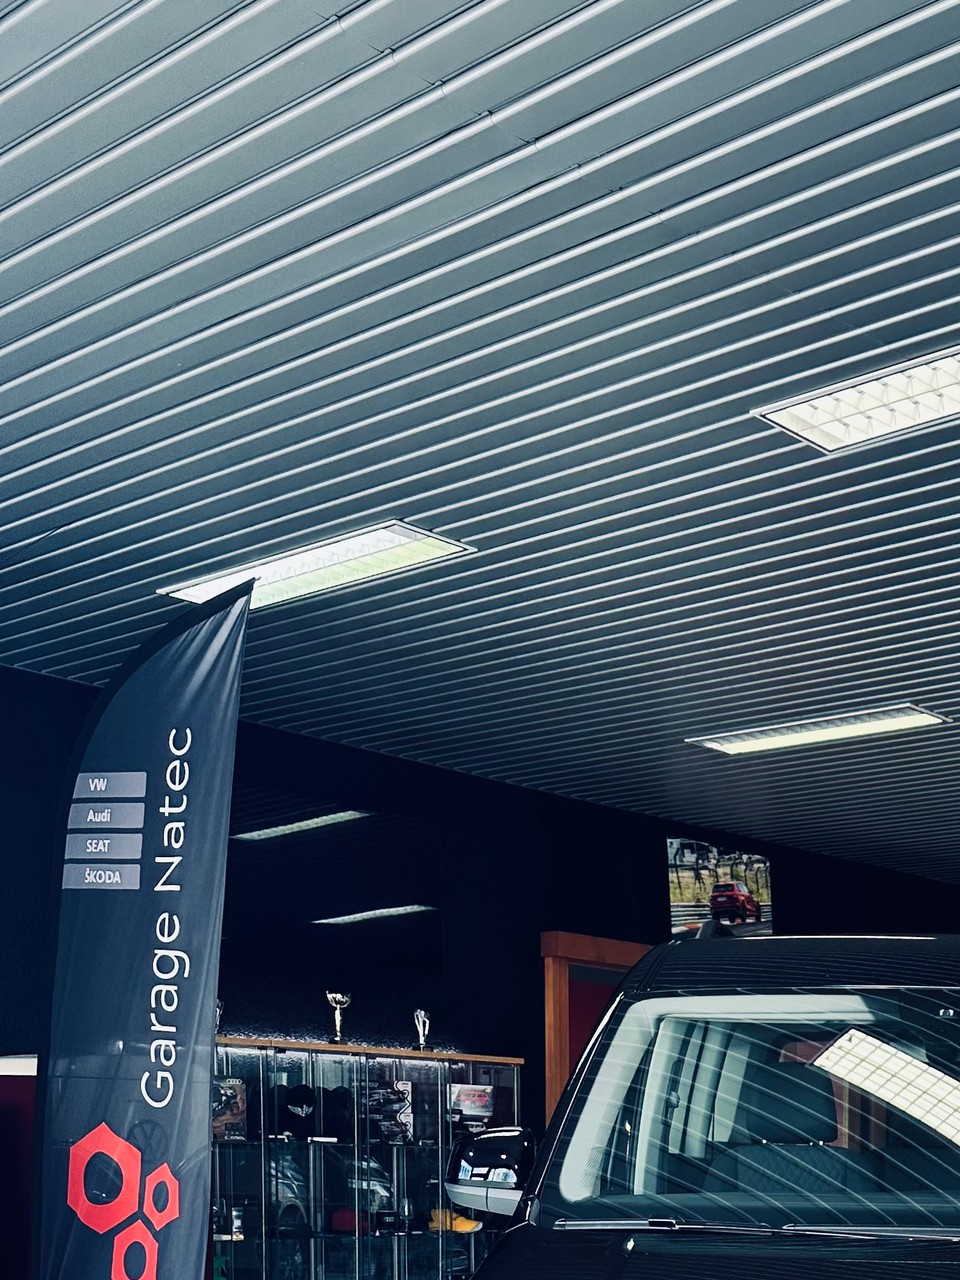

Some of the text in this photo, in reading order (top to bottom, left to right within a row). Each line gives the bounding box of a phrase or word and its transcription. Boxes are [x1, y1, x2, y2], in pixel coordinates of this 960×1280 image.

[89, 778, 108, 791] VW
[86, 808, 112, 823] Audi
[86, 839, 111, 853] SEAT
[84, 867, 121, 884] ŠKODA
[140, 727, 192, 1109] Garage Natec
